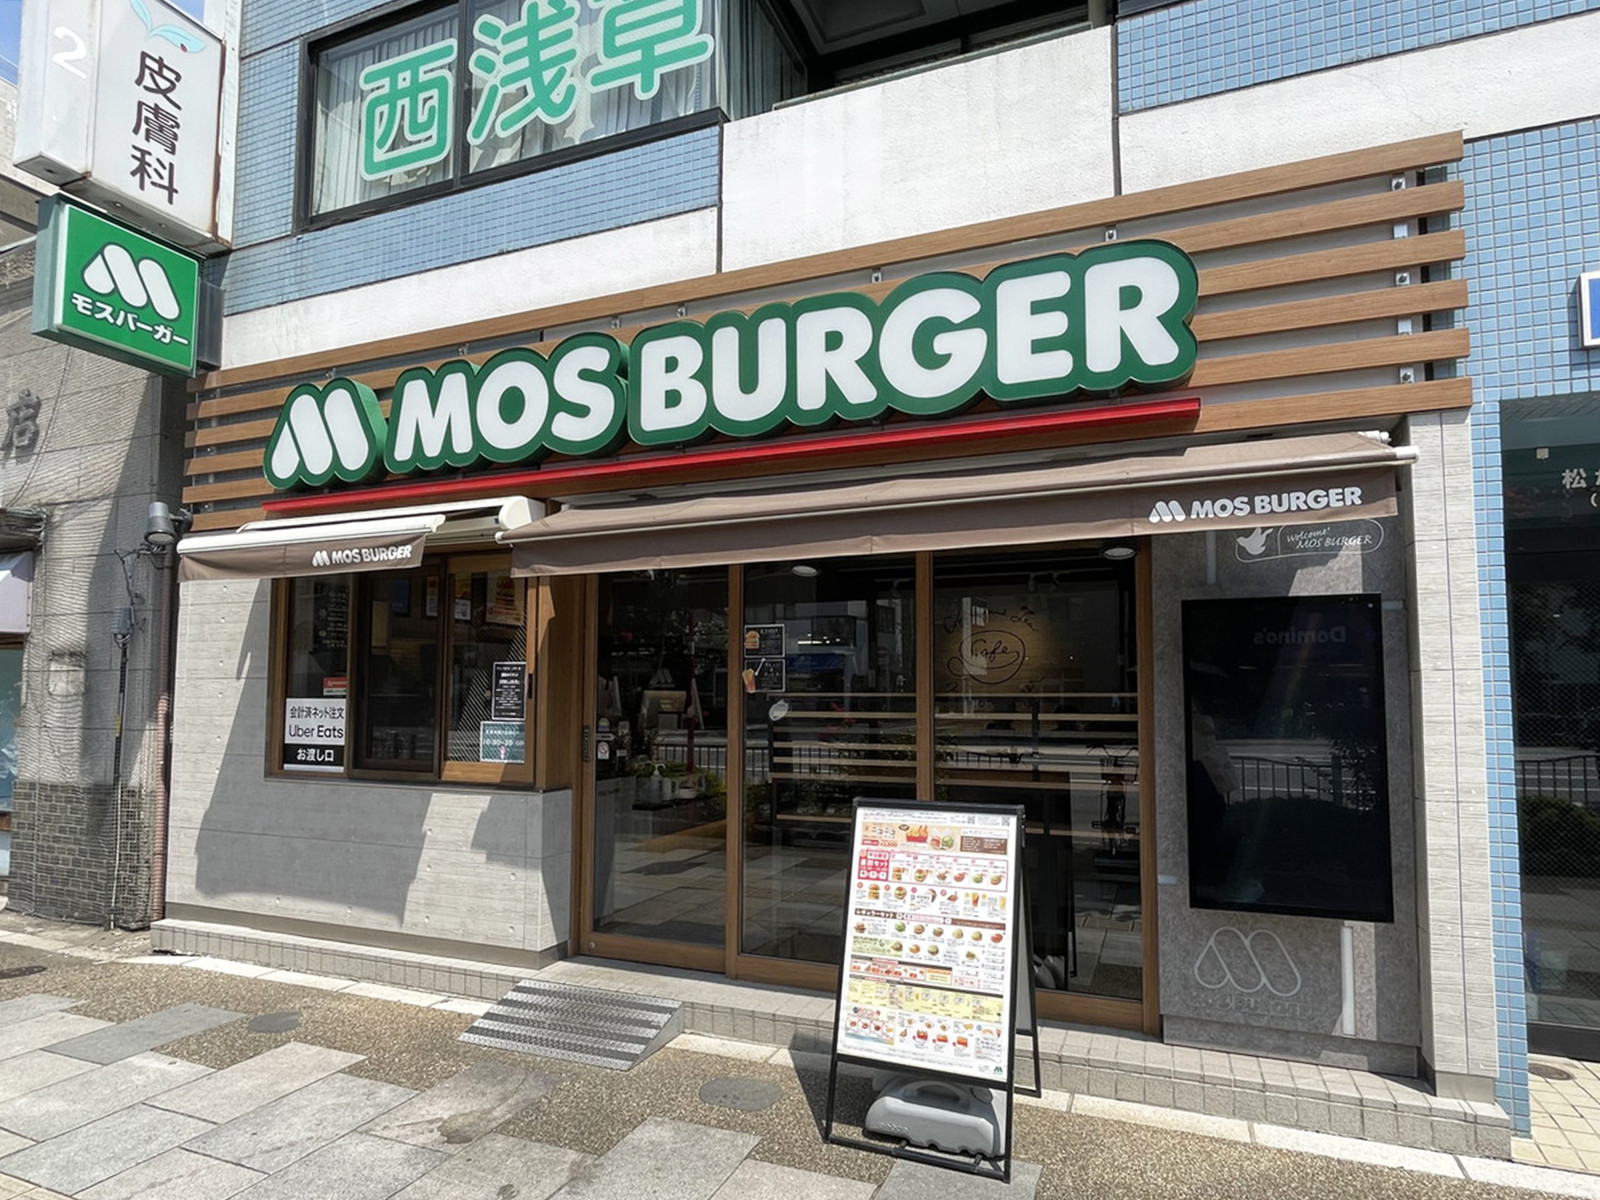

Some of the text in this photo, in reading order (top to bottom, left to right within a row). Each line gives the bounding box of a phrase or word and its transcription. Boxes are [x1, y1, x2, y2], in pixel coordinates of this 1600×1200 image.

[130, 50, 182, 205] 皮膚科
[71, 292, 189, 345] モスバーガー
[393, 346, 616, 462] MOS
[639, 256, 1181, 432] BURGER
[1190, 496, 1251, 519] MOS
[1254, 486, 1362, 514] BURGER
[1296, 534, 1373, 549] MOS BURGER
[331, 548, 360, 564] MOS
[360, 545, 413, 562] BURGER
[289, 705, 345, 720] 会計済ネット注文
[288, 724, 344, 739] Uber Eats
[296, 748, 335, 762] お渡し口
